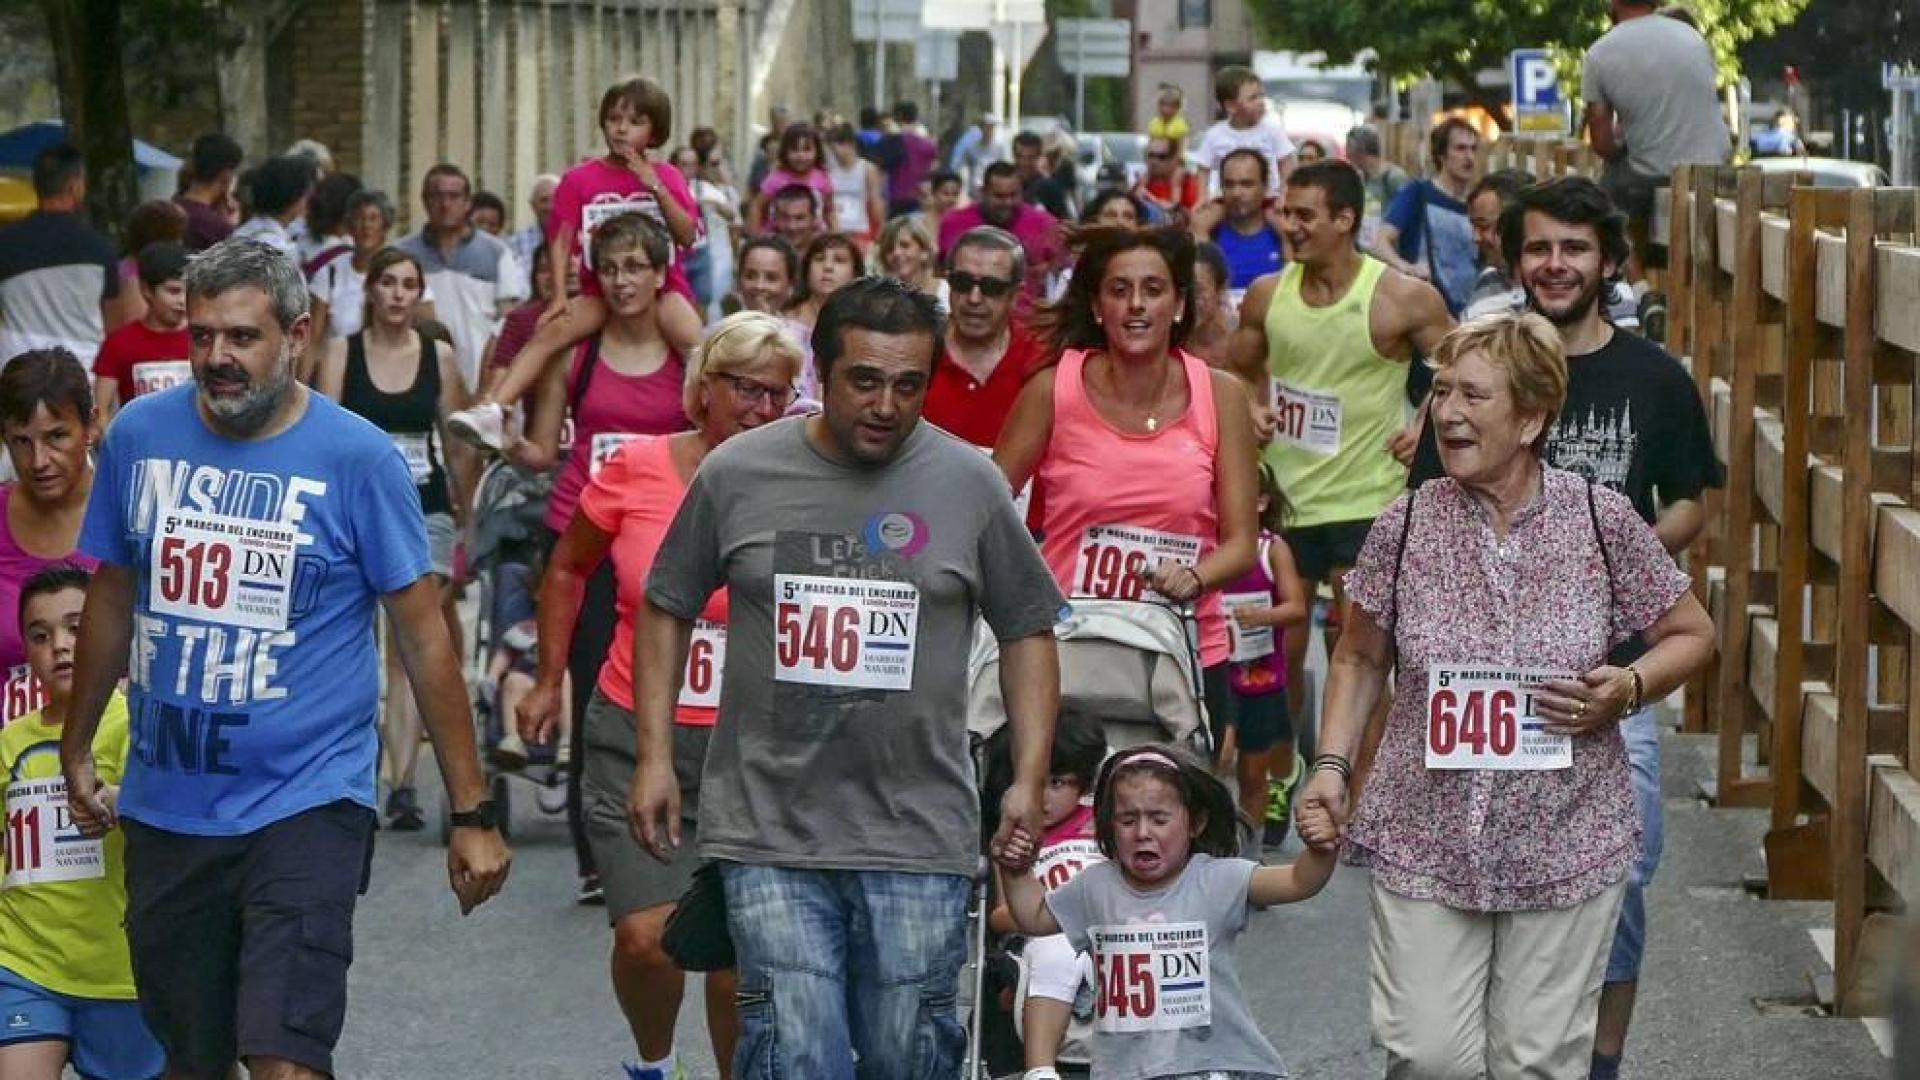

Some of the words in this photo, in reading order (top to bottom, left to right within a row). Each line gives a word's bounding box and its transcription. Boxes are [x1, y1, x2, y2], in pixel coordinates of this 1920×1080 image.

[1525, 60, 1556, 101] P
[184, 518, 226, 534] MARCHA
[228, 524, 244, 537] DEL
[246, 526, 294, 543] ENCIERRO
[160, 536, 232, 610] 513
[242, 549, 287, 579] DN
[1082, 543, 1147, 601] 198
[803, 582, 846, 596] MARCHA
[848, 586, 865, 598] DEL
[868, 588, 916, 600] ENCIERRO
[778, 602, 860, 673] 546
[867, 610, 910, 637] DN
[175, 627, 296, 705] THE
[690, 638, 713, 695] 6
[1460, 670, 1501, 680] MARCHA
[1505, 672, 1522, 682] DEL
[1430, 689, 1517, 757] 646
[1138, 932, 1153, 942] DEL
[1157, 929, 1203, 941] ENCIERRO
[1161, 951, 1203, 979] DN
